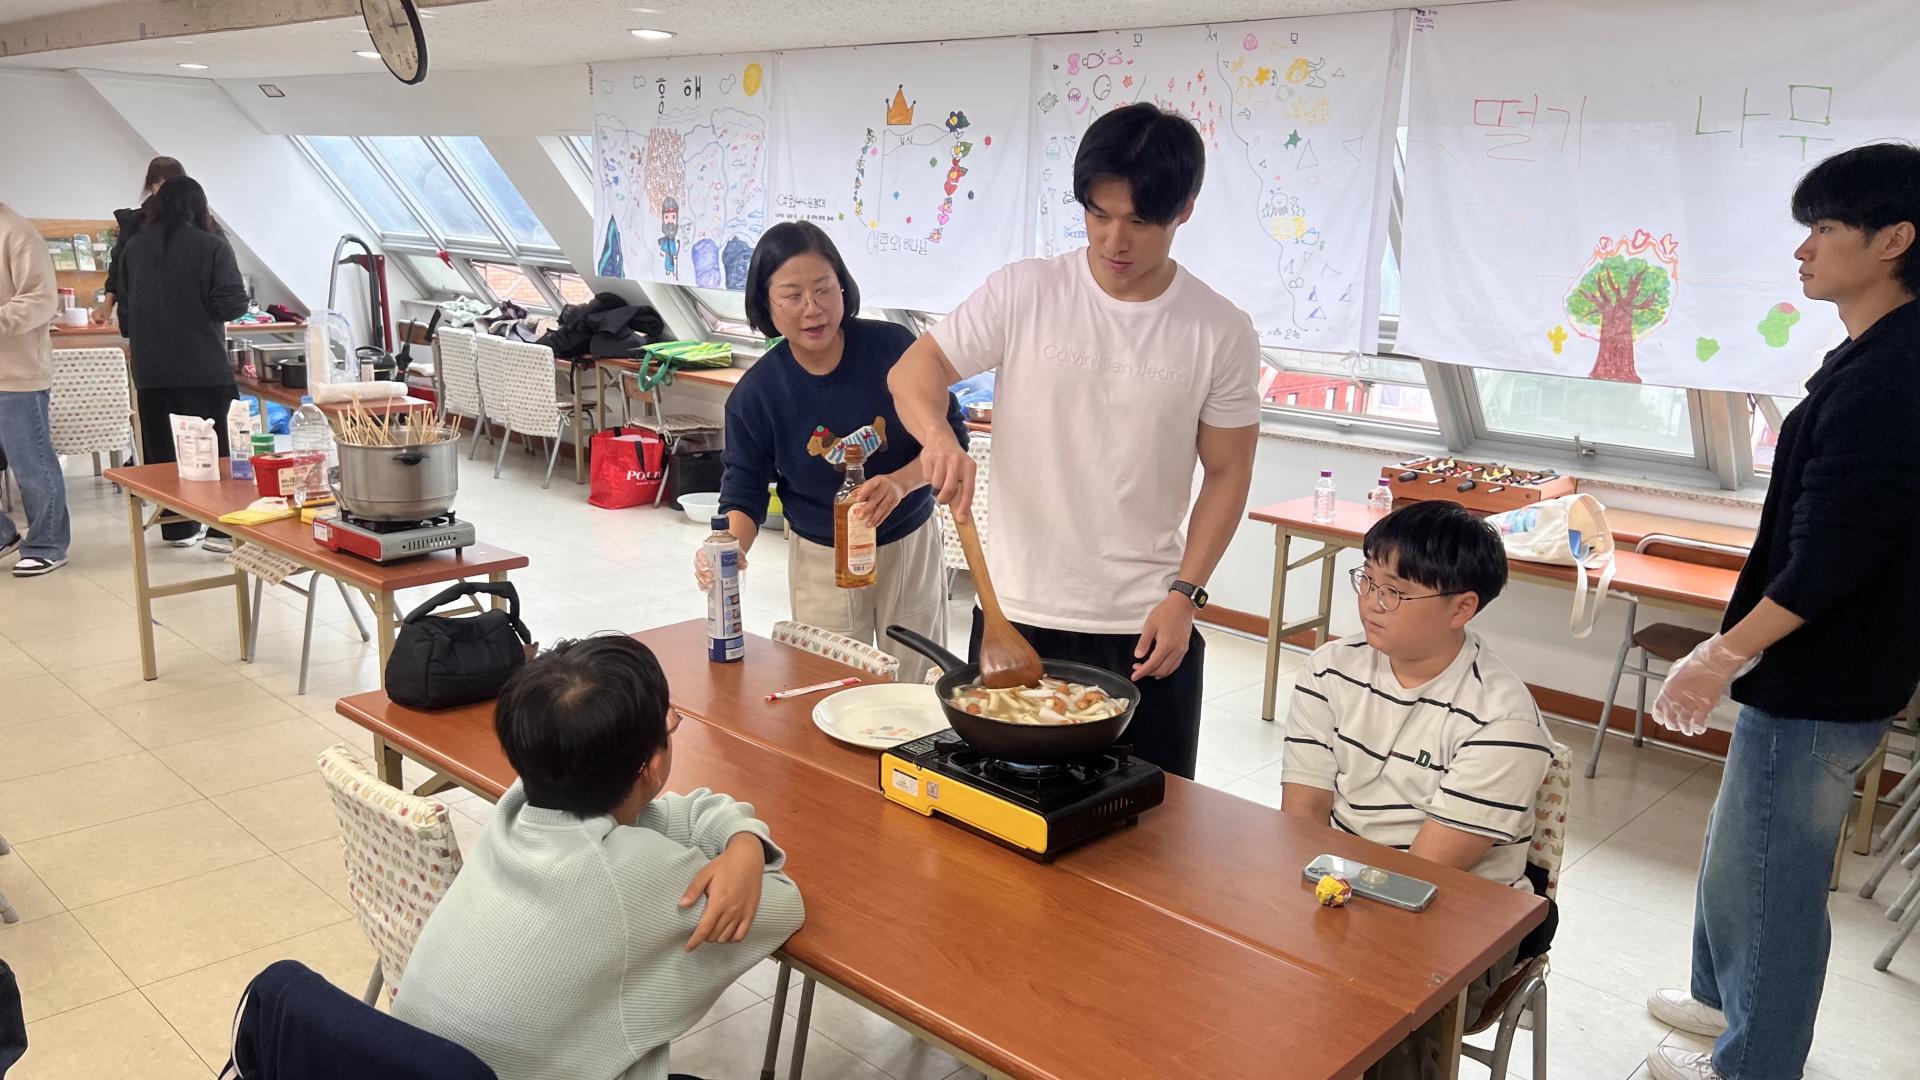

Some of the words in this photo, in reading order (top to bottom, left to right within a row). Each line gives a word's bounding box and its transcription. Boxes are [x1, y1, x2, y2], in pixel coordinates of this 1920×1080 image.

[1694, 84, 1835, 162] 나무
[1043, 344, 1094, 367] Calvin
[1414, 748, 1432, 769] D
